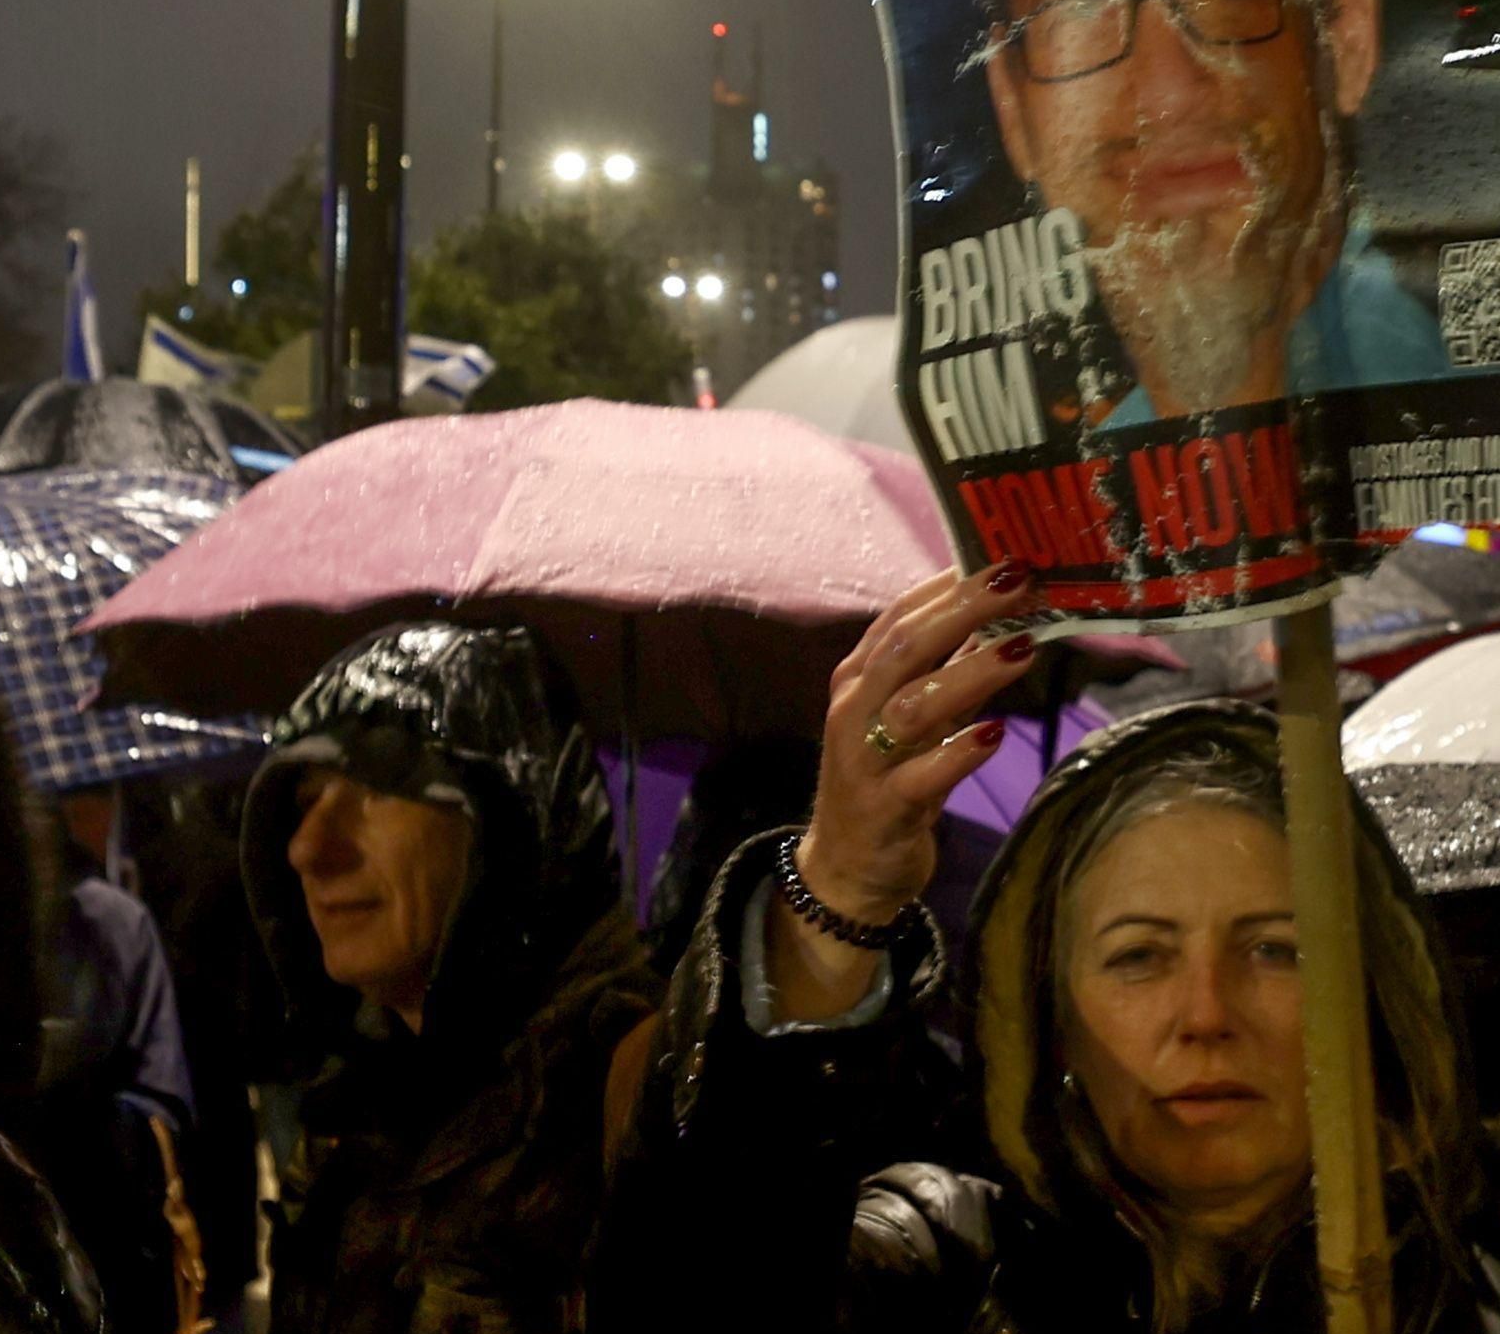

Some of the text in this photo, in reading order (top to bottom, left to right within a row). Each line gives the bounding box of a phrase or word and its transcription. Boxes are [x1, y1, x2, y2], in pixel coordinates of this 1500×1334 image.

[920, 206, 1094, 351] BRING
[918, 341, 1048, 464] HIM
[959, 457, 1126, 569] HOME
[1354, 475, 1467, 533] FAMILIES
